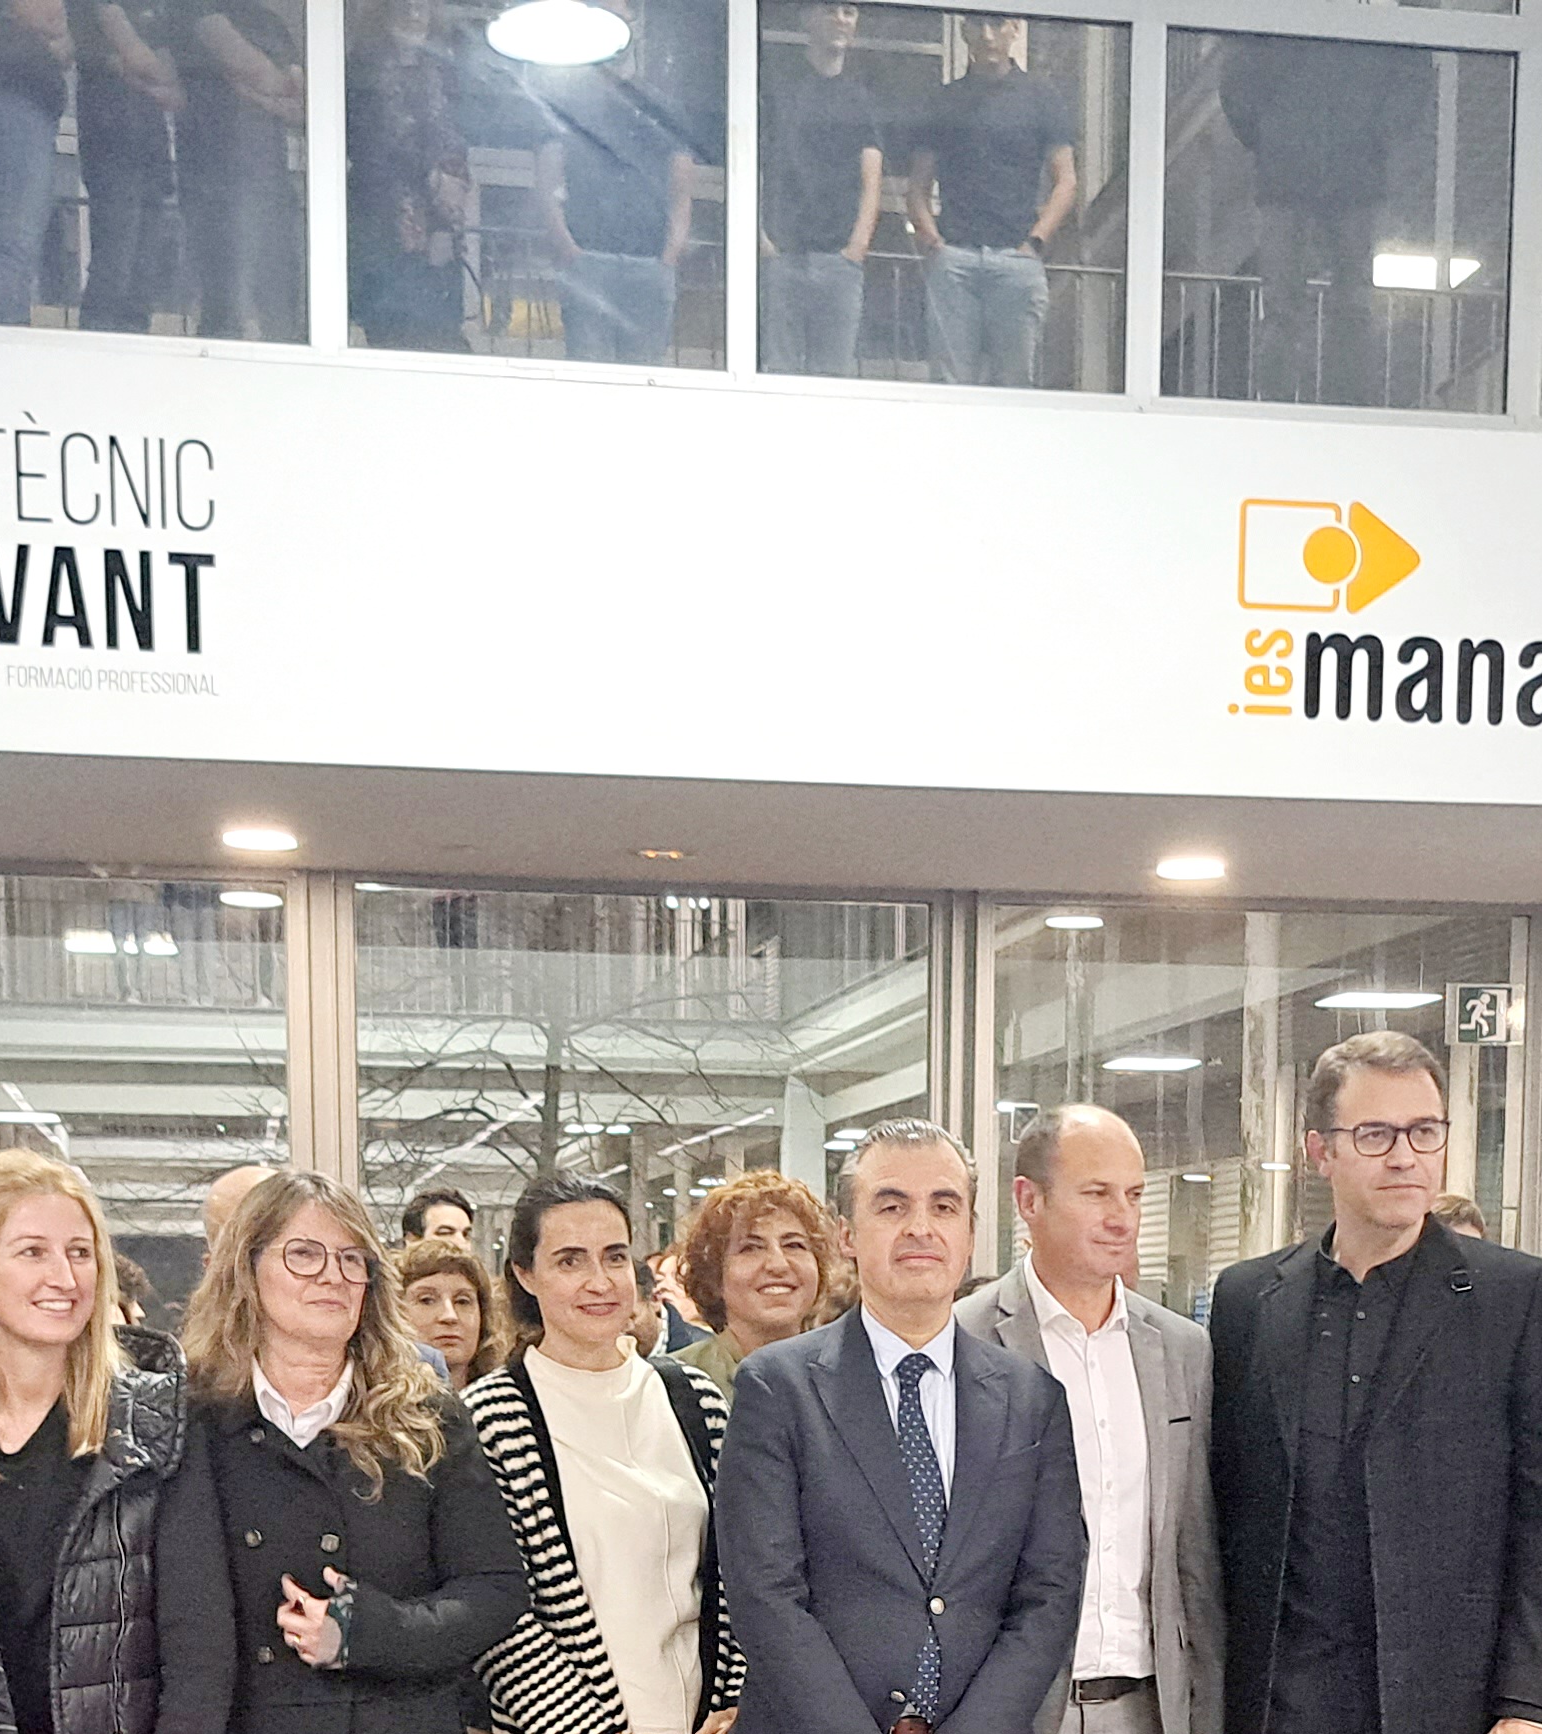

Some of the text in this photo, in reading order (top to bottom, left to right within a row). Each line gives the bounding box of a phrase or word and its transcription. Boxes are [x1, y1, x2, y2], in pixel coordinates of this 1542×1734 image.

[7, 664, 93, 691] FORMACIÓ
[97, 669, 219, 697] PROFESSIONAL
[1228, 629, 1294, 716] ies
